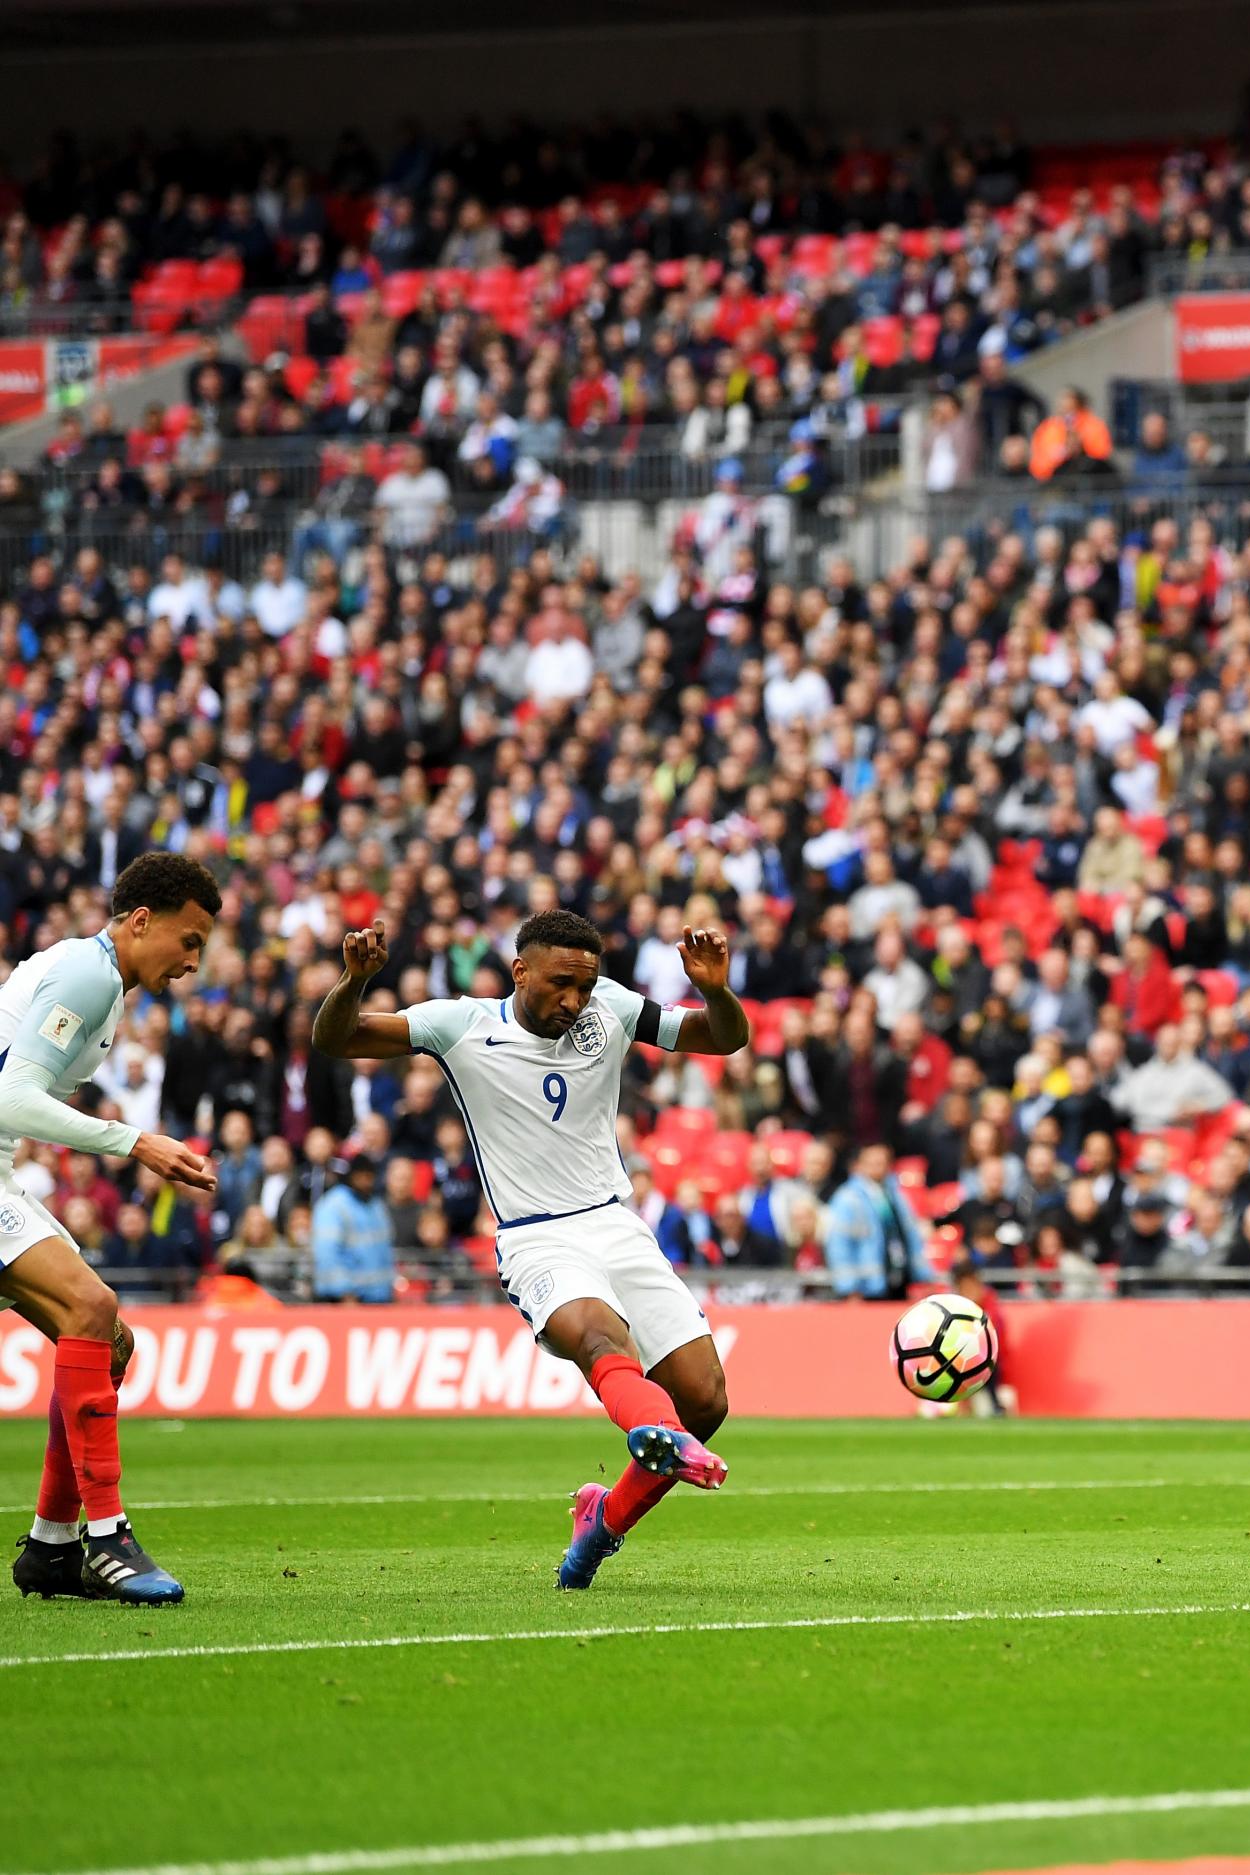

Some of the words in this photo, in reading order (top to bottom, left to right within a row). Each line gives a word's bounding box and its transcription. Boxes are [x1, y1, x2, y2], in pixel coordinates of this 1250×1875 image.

[543, 1073, 567, 1122] 9
[115, 1326, 218, 1411] OU
[232, 1327, 331, 1411] TO
[347, 1327, 738, 1411] WEMB
